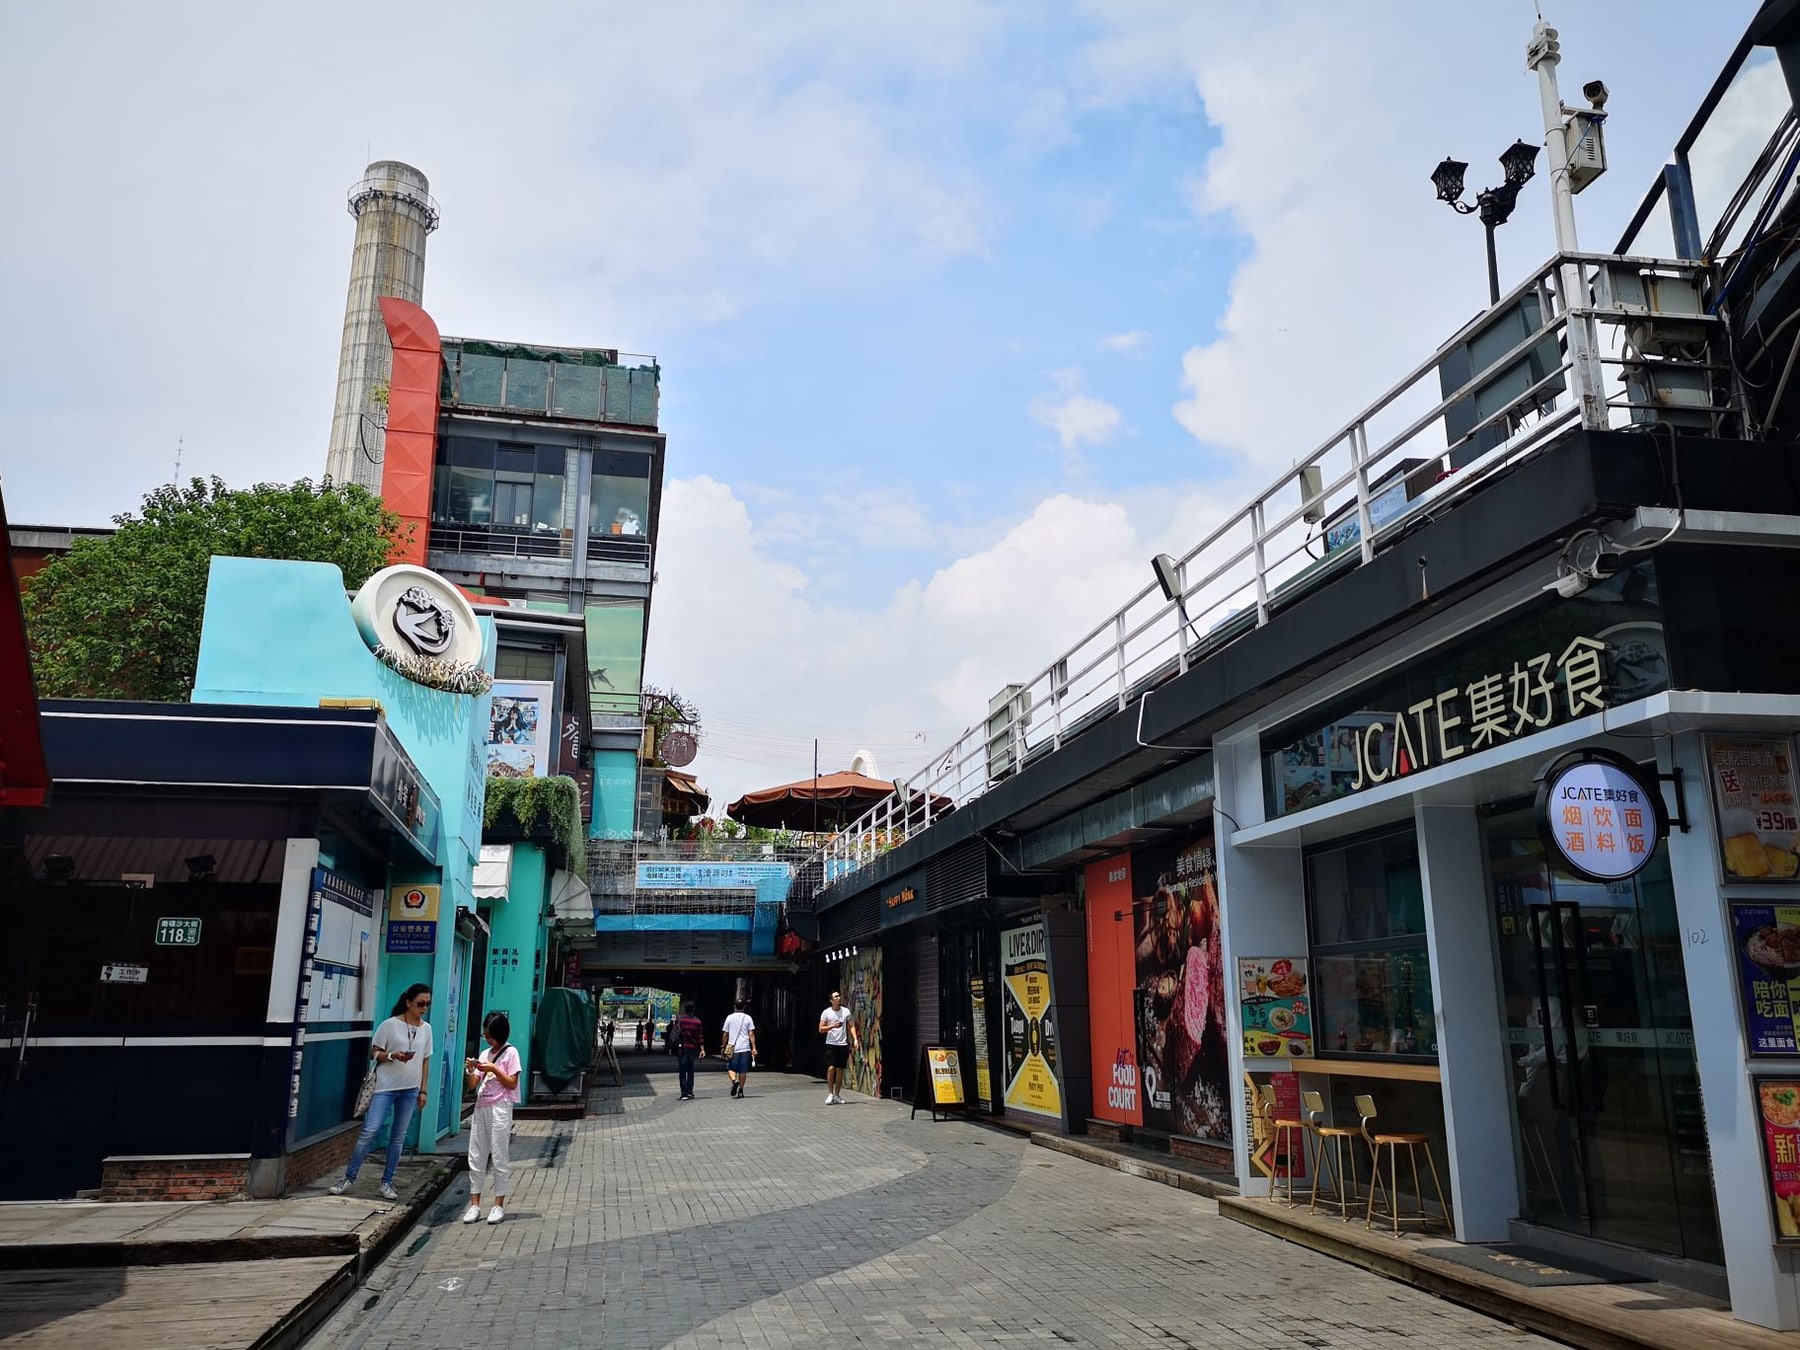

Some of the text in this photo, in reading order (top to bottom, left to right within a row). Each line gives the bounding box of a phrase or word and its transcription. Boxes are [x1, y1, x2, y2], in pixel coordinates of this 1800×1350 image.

[1351, 636, 1605, 790] JCATE 集好食
[1720, 769, 1741, 792] 送
[1561, 786, 1640, 803] JCATE 集好食
[1687, 928, 1711, 948] 102
[1753, 980, 1787, 999] 陪你
[1756, 1000, 1790, 1018] 吃面
[1758, 1037, 1795, 1048] 这里面食
[1113, 1063, 1136, 1086] FOOD
[1108, 1086, 1136, 1111] COURT
[1244, 1087, 1255, 1155] RECRUITMENT
[1774, 1133, 1800, 1166] 新
